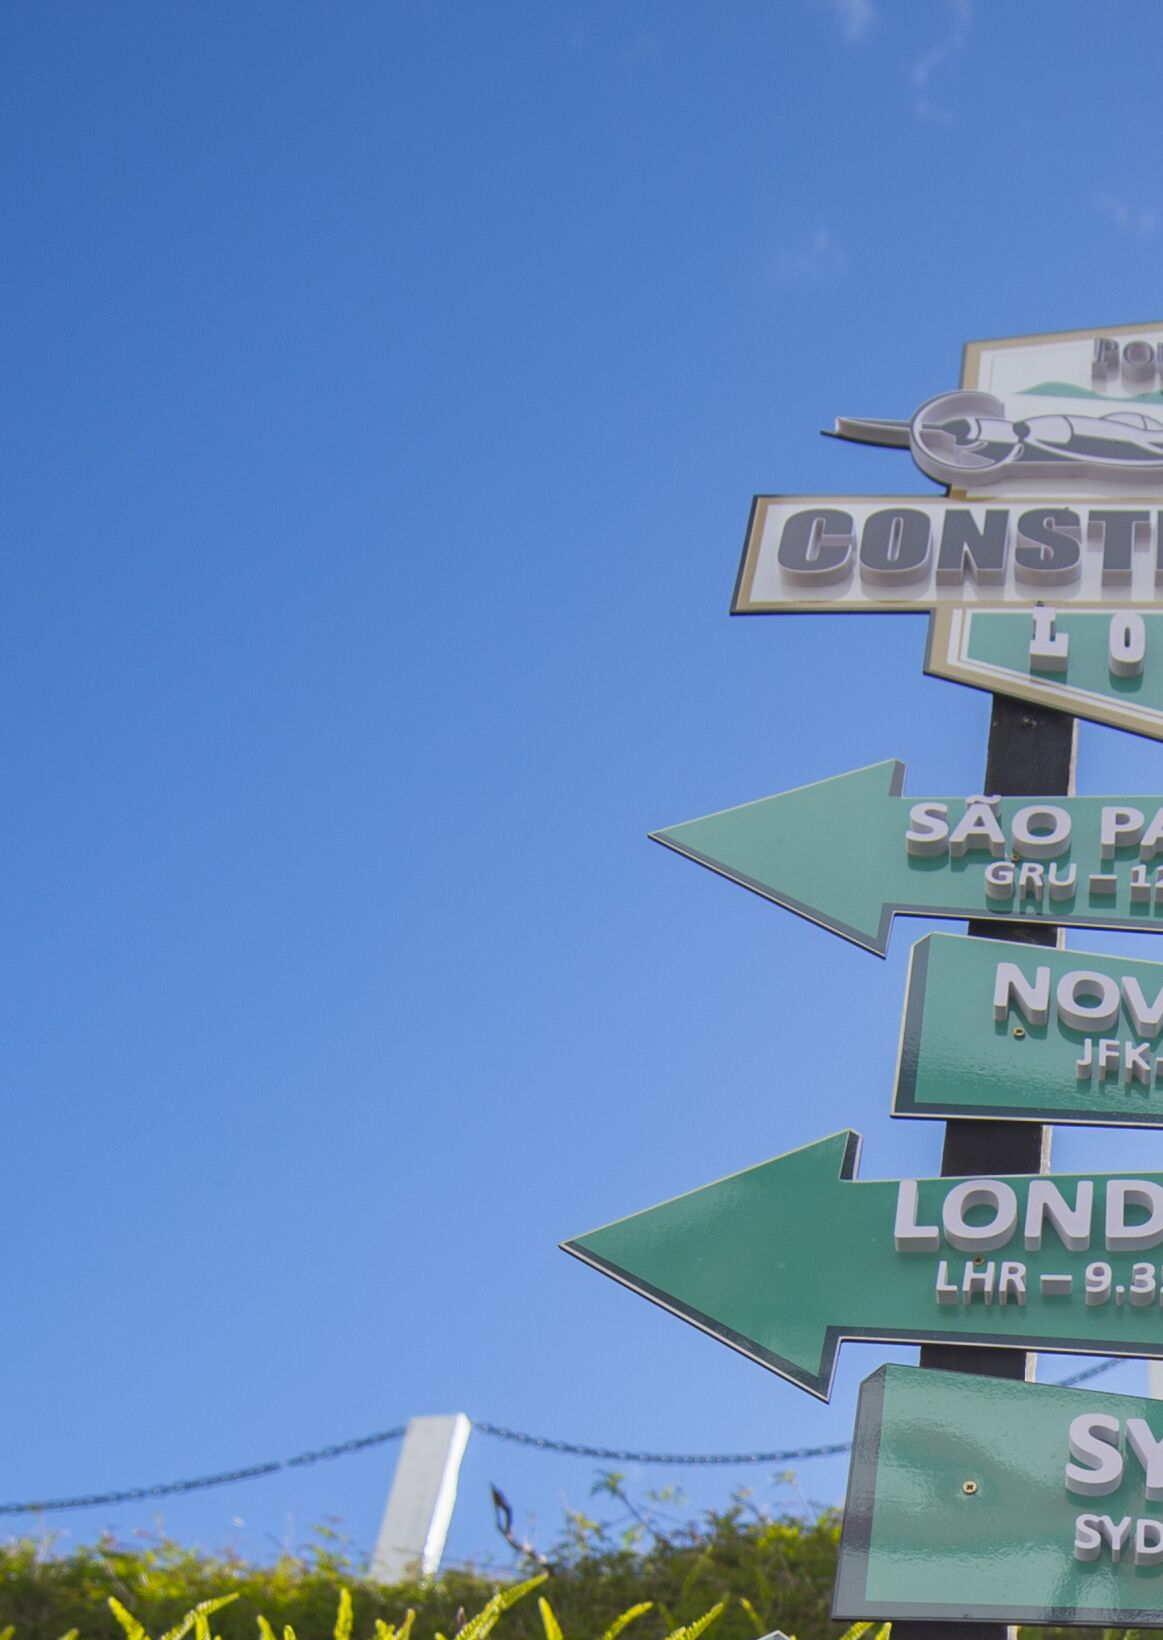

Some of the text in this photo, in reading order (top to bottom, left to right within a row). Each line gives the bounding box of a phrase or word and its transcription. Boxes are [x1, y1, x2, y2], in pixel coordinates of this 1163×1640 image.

[906, 795, 1072, 859] SÃO
[984, 861, 1077, 900] GRU
[936, 1261, 1027, 1306] LHR
